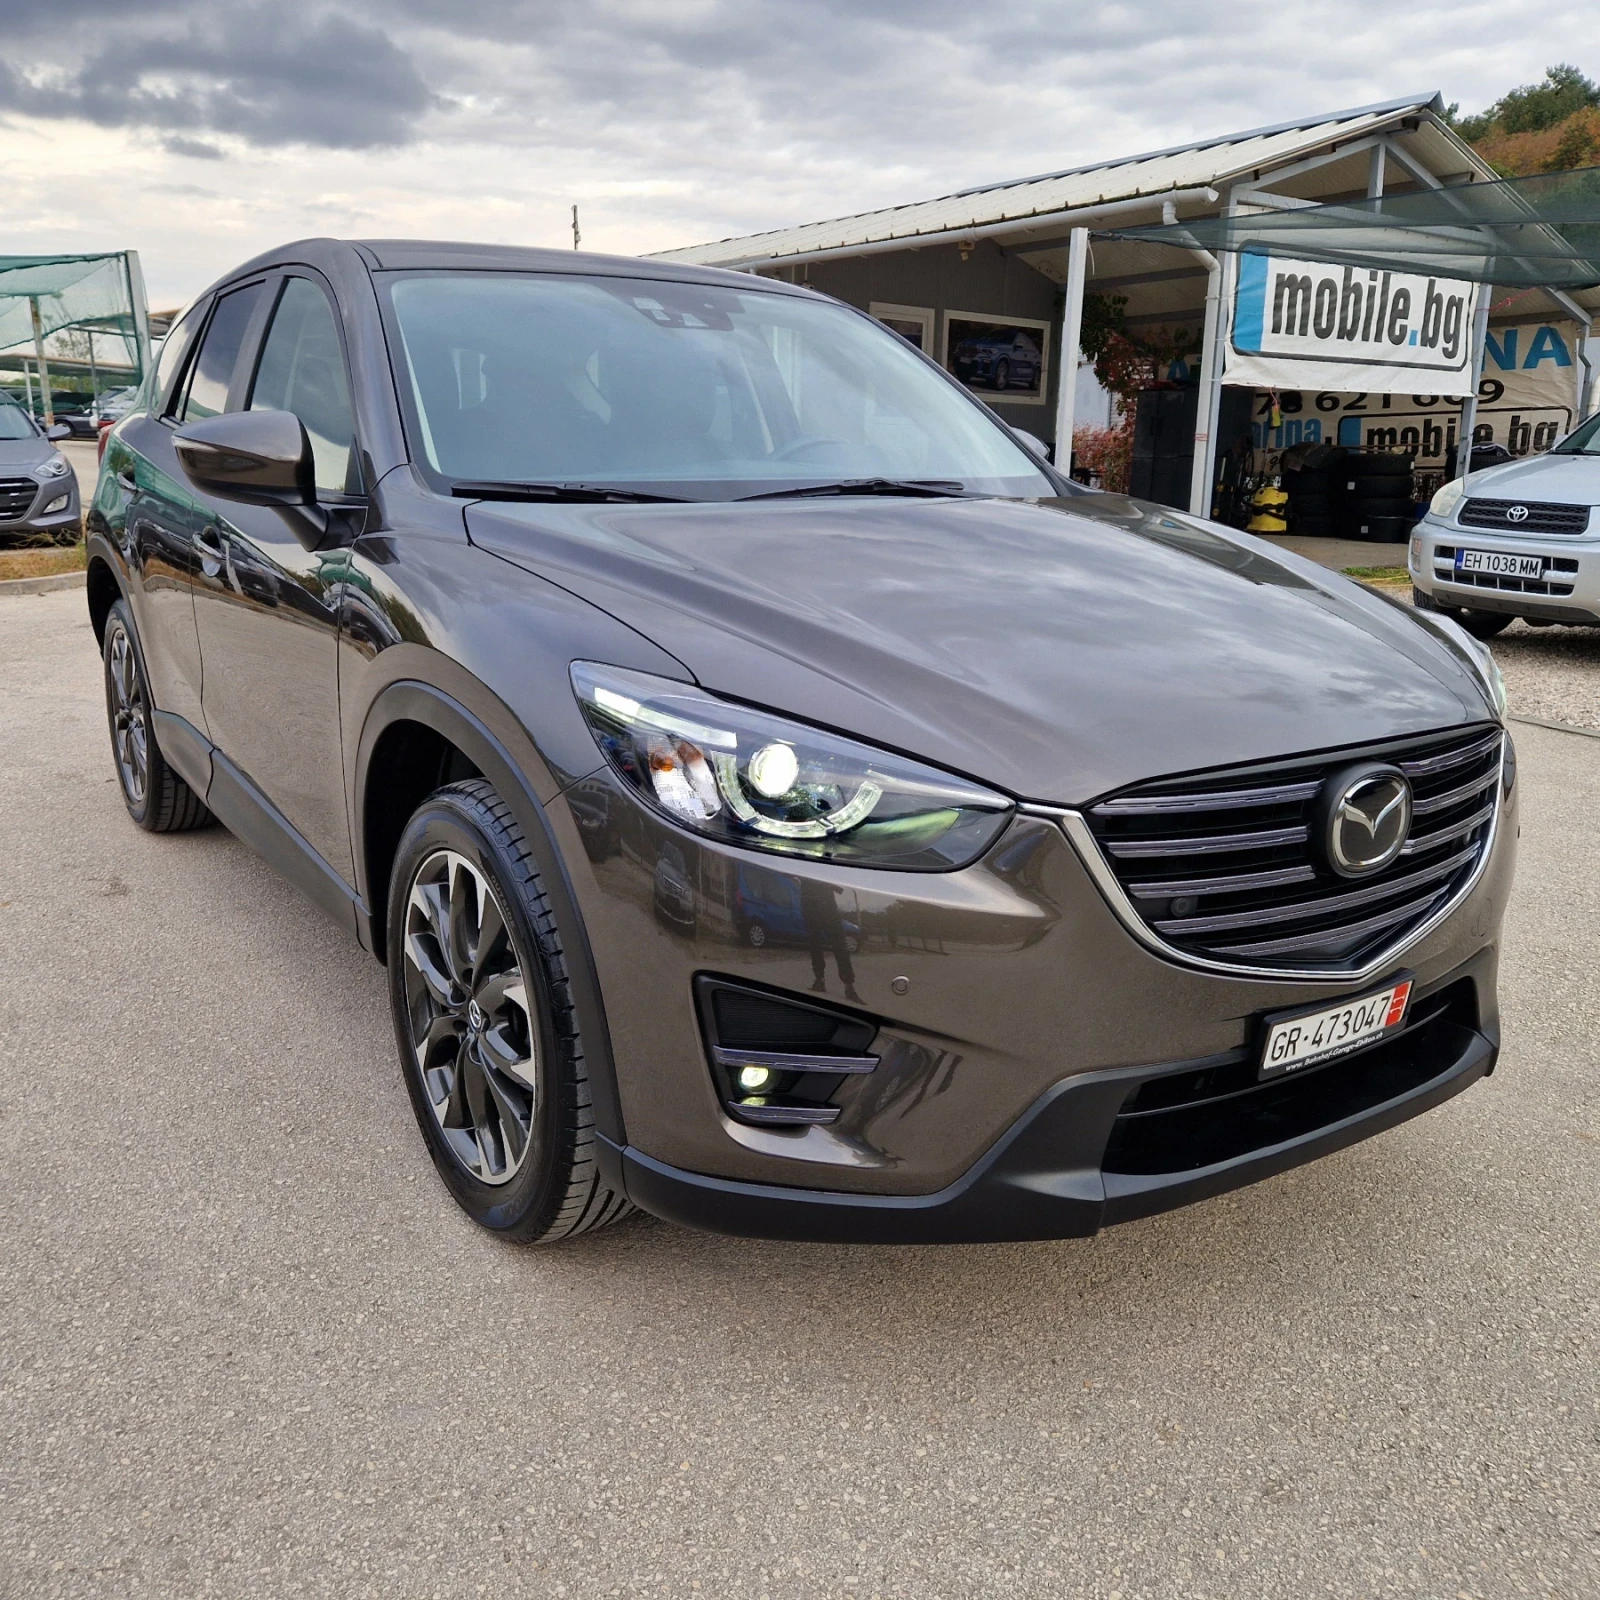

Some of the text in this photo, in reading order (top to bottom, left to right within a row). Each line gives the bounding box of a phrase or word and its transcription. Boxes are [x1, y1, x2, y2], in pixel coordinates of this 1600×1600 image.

[1271, 266, 1464, 359] mobile.bg
[1464, 552, 1539, 576] EH 1038 MM
